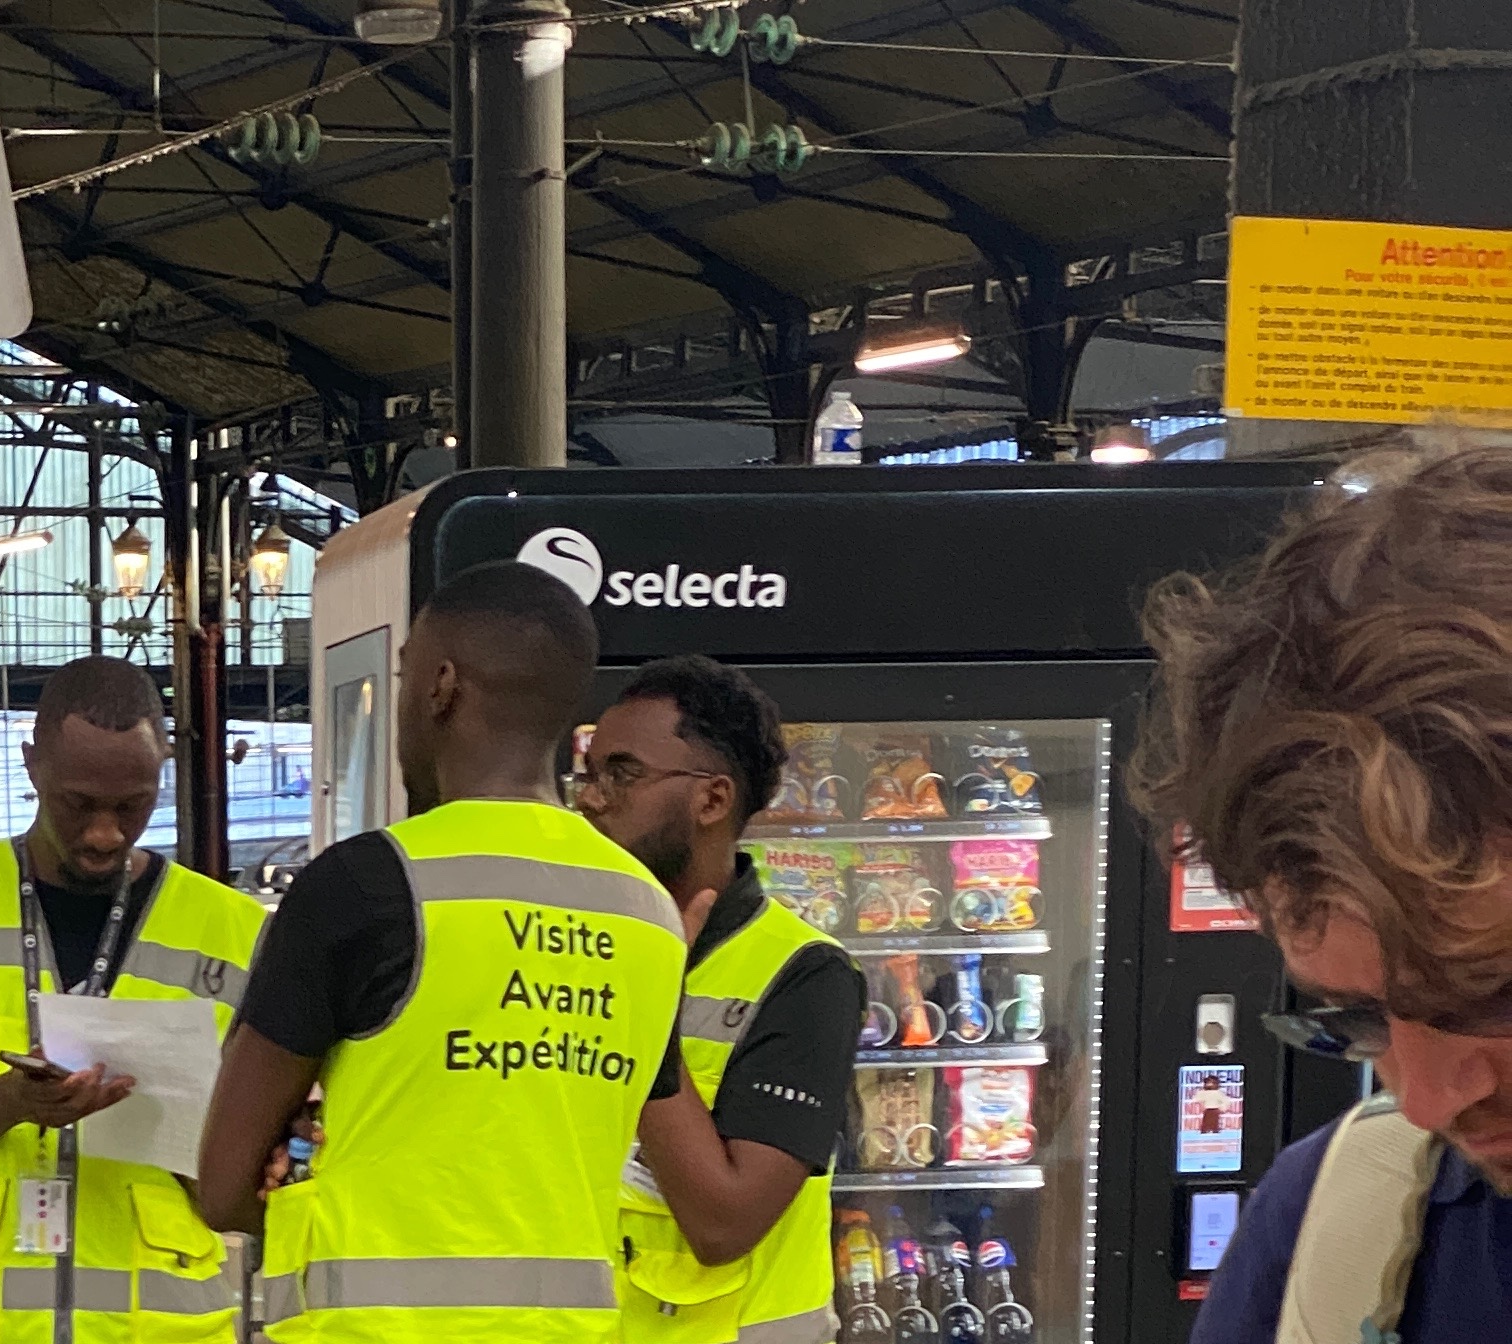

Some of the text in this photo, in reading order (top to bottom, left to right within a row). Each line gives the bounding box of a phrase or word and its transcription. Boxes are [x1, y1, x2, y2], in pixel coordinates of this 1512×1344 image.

[604, 563, 787, 609] selecta
[766, 850, 836, 871] HARIBO
[504, 910, 615, 960] Visite
[499, 970, 615, 1020] Avant
